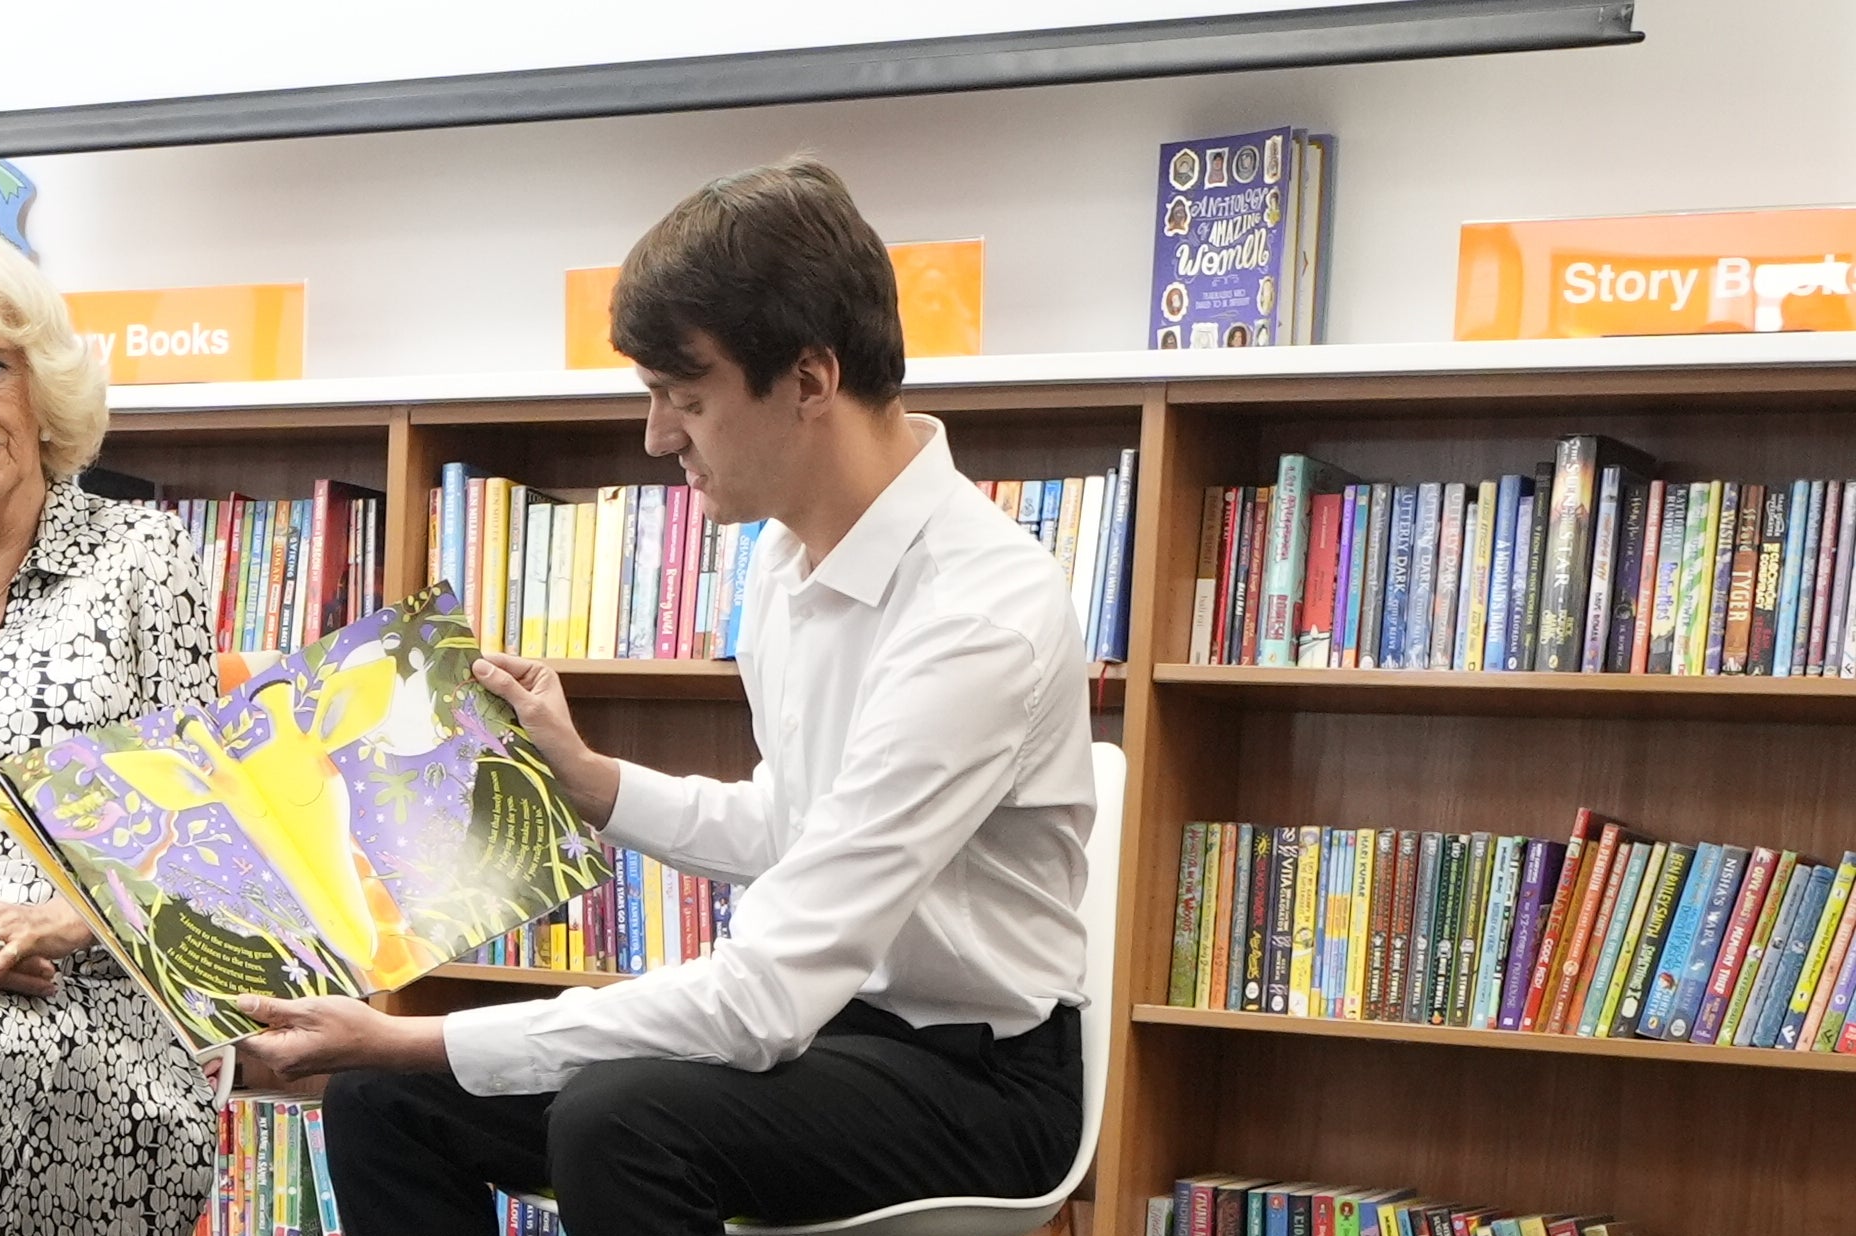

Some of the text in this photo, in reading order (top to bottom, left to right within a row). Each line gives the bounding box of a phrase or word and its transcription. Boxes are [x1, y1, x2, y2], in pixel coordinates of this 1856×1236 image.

[1191, 188, 1268, 217] ANTHOLOGY
[1209, 213, 1261, 247] AMAZING
[1563, 262, 1699, 311] Story
[126, 322, 229, 356] Books
[1564, 463, 1580, 507] SUN
[445, 494, 455, 534] MILLER
[1398, 494, 1412, 551] UTTERLY
[1421, 492, 1438, 550] UTTERLY
[1448, 493, 1462, 550] UTTERLY
[1663, 495, 1676, 546] RUNDELL
[1671, 489, 1687, 551] KATHERINE
[287, 541, 297, 578] VIKING
[312, 536, 323, 570] DRAGON
[1419, 553, 1433, 591] DARK
[1553, 530, 1573, 588] STAR
[660, 568, 678, 609] Running
[1394, 555, 1408, 593] DARK
[1443, 554, 1457, 593] DARK
[1492, 550, 1509, 610] MERMAID'S
[1755, 554, 1769, 609] CONSPIRACY
[1764, 553, 1779, 611] CLOCKWORK
[1389, 599, 1399, 625] PHILIP
[1683, 594, 1693, 628] POWER
[1728, 570, 1752, 621] TYGER
[662, 611, 673, 635] Wild
[1488, 612, 1504, 643] DIARY
[1510, 614, 1520, 653] RIORDAN
[1280, 858, 1293, 887] VITA
[1357, 861, 1367, 897] KUMAR
[1589, 850, 1611, 891] PENGUIN
[1668, 853, 1685, 873] BEN
[1656, 874, 1677, 907] BAILEY
[1704, 858, 1738, 938] NISHA'S WAR
[1182, 897, 1195, 932] WOODS
[1276, 888, 1286, 932] GLADIATOR
[1549, 890, 1569, 933] NATE
[1646, 906, 1667, 938] SMITH
[211, 936, 223, 946] the
[224, 942, 254, 959] swaying
[631, 929, 641, 951] NICOL
[1714, 866, 1764, 995] OLIVE MEMORY THIEF
[185, 934, 201, 947] And
[200, 945, 222, 959] listen
[231, 956, 244, 967] the
[188, 949, 200, 960] me
[200, 956, 213, 967] the
[213, 962, 244, 980] sweetest
[244, 973, 267, 984] music
[1540, 937, 1554, 965] CODE
[1630, 943, 1655, 990] SOMETHING
[175, 953, 195, 970] those
[194, 965, 228, 987] branches
[1647, 987, 1663, 1016] SMITH
[1658, 988, 1674, 1017] CHRIS
[1178, 1190, 1189, 1236] FINDING
